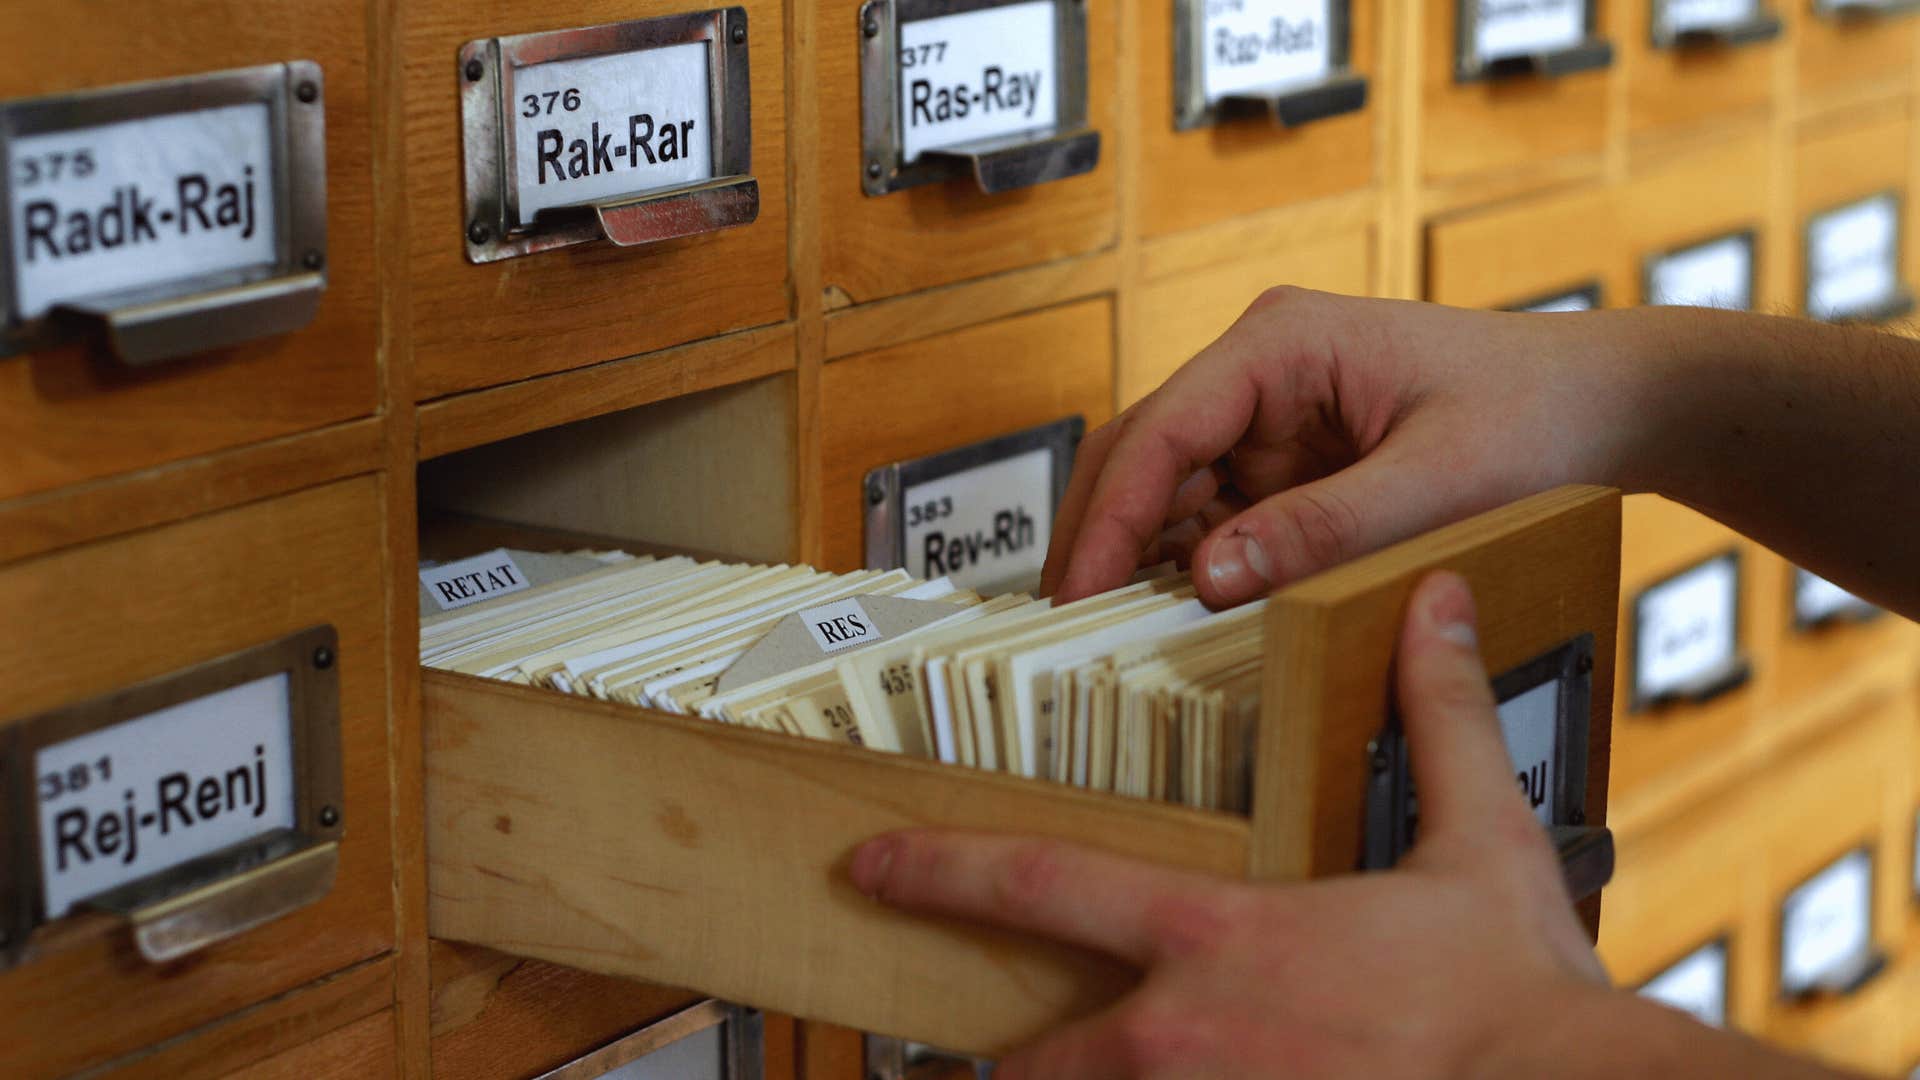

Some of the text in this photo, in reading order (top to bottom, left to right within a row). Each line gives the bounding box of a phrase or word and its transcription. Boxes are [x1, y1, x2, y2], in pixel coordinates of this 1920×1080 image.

[900, 40, 948, 67] 377
[523, 88, 581, 118] 376
[911, 66, 1041, 127] Ras-Ray
[537, 113, 695, 184] Rak-Rar
[25, 164, 255, 262] Radk-Raj
[909, 496, 953, 526] 383
[924, 505, 1034, 580] Rev-Rh
[435, 564, 518, 602] RETAT
[816, 614, 866, 644] RES
[41, 756, 112, 801] 381
[55, 744, 266, 873] Rej-Renj
